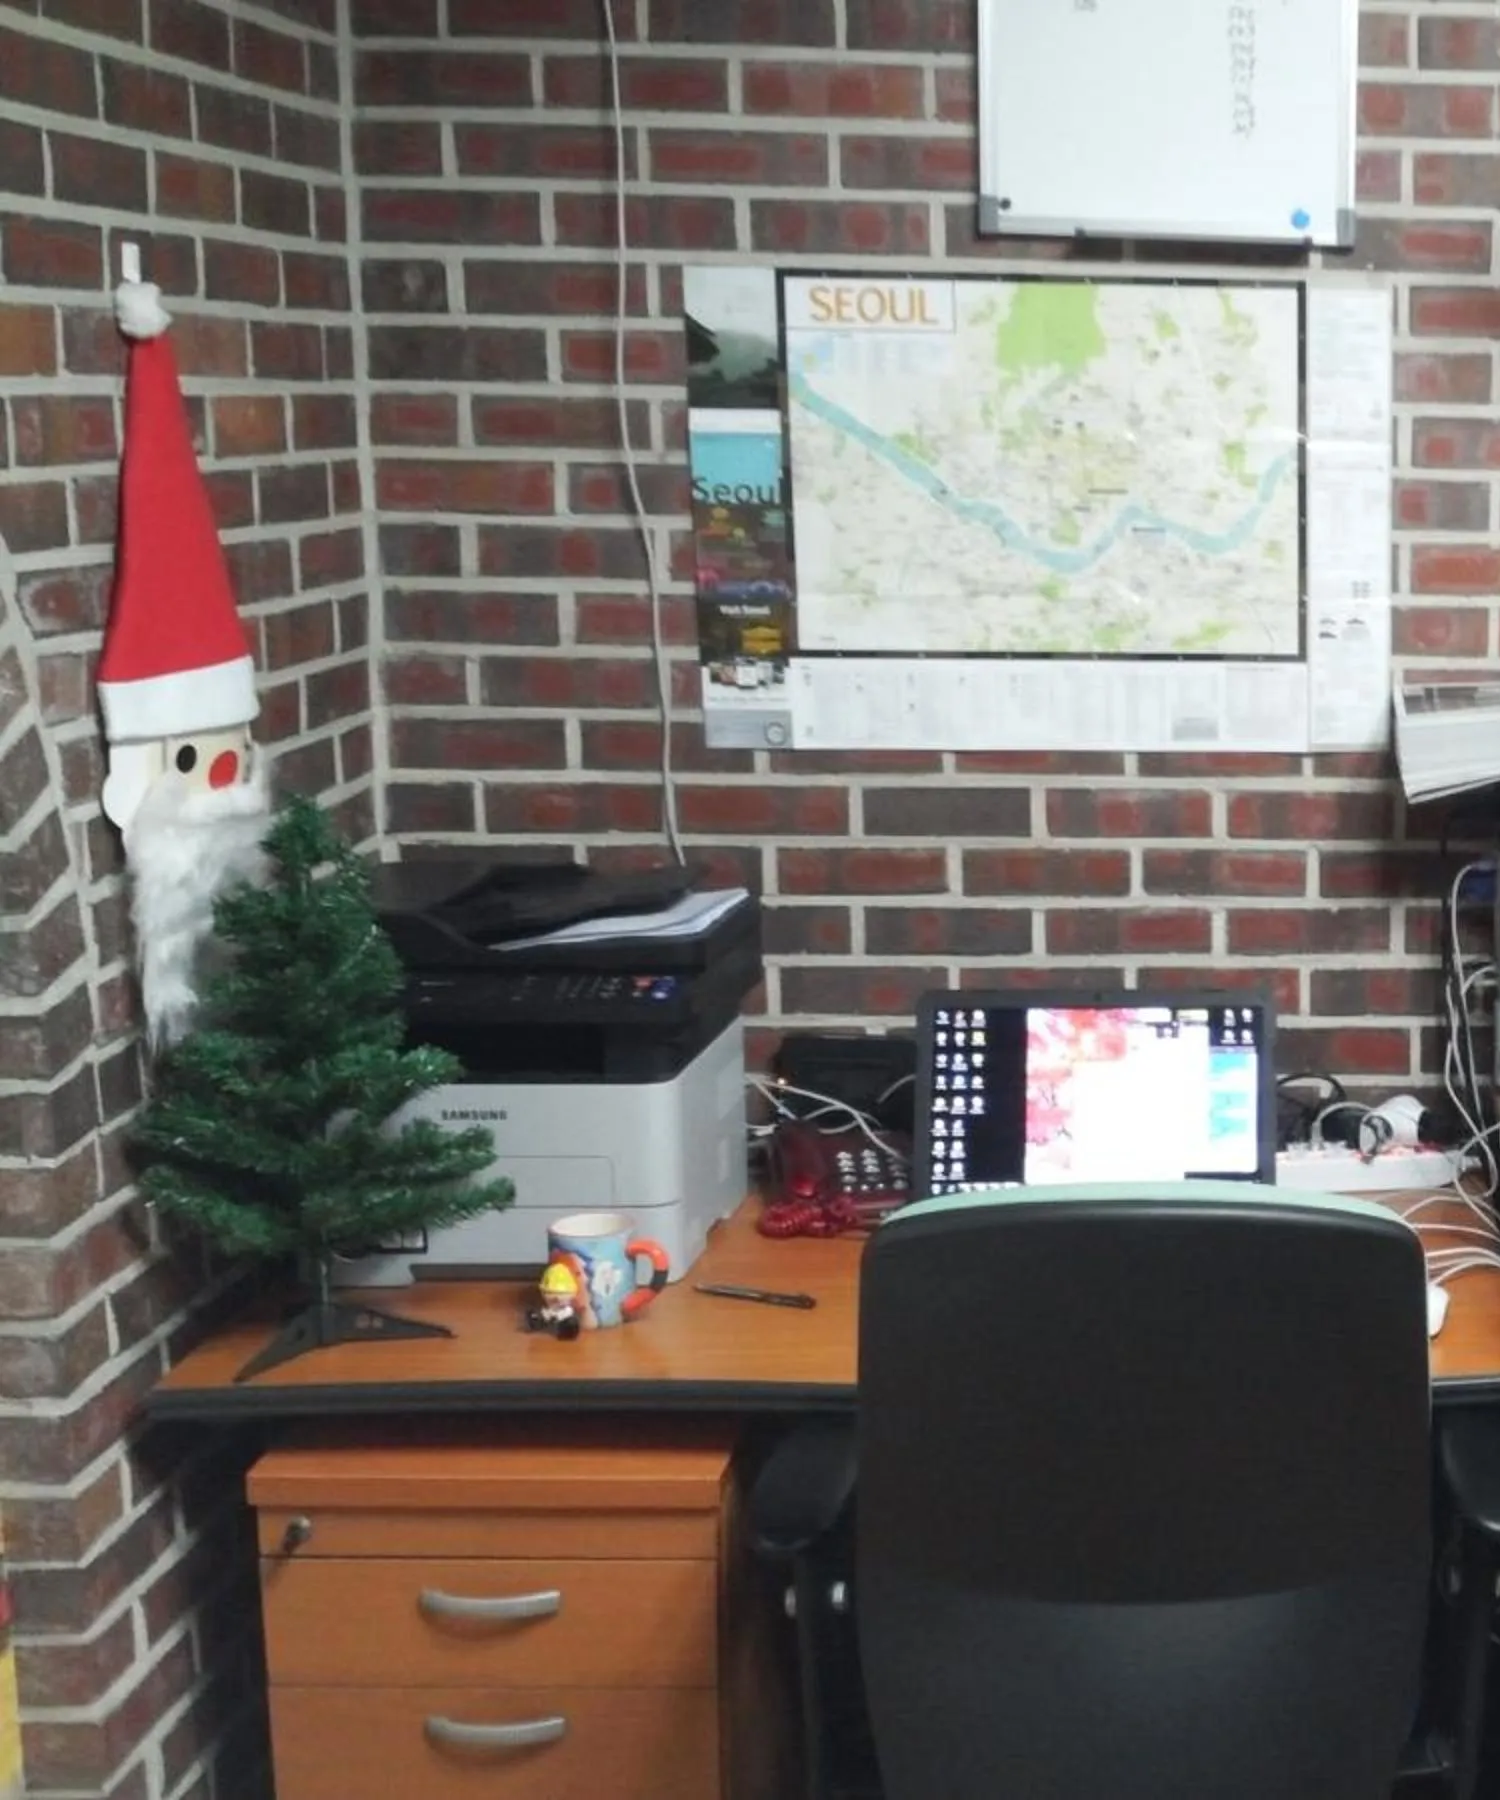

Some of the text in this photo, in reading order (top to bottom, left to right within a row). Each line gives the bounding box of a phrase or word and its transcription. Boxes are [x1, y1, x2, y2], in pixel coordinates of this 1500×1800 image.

[808, 284, 939, 325] SEOUL
[692, 475, 785, 506] Seoul
[441, 1109, 508, 1121] SAMSUNG
